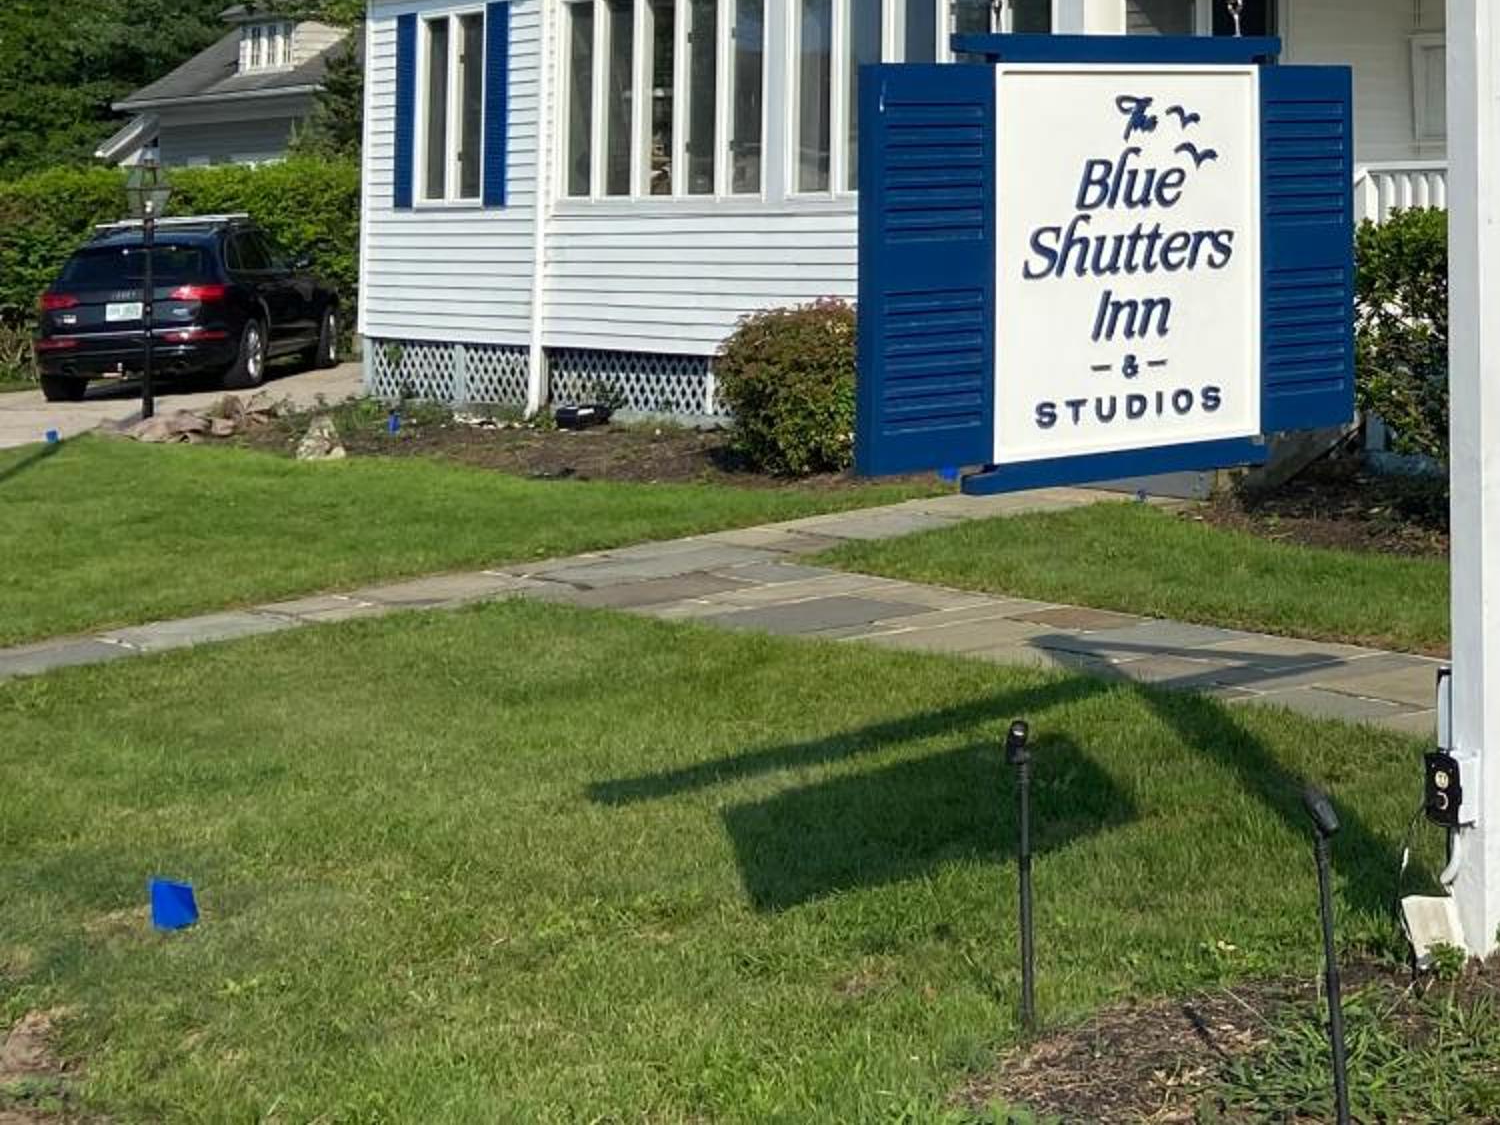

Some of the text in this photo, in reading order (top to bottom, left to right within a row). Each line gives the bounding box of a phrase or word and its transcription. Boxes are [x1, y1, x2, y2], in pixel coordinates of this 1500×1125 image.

[1115, 94, 1159, 142] The
[1075, 146, 1186, 210] Blue
[1022, 213, 1234, 280] Shutters
[1090, 289, 1172, 342] Inn
[1034, 385, 1222, 429] STUDIOS
